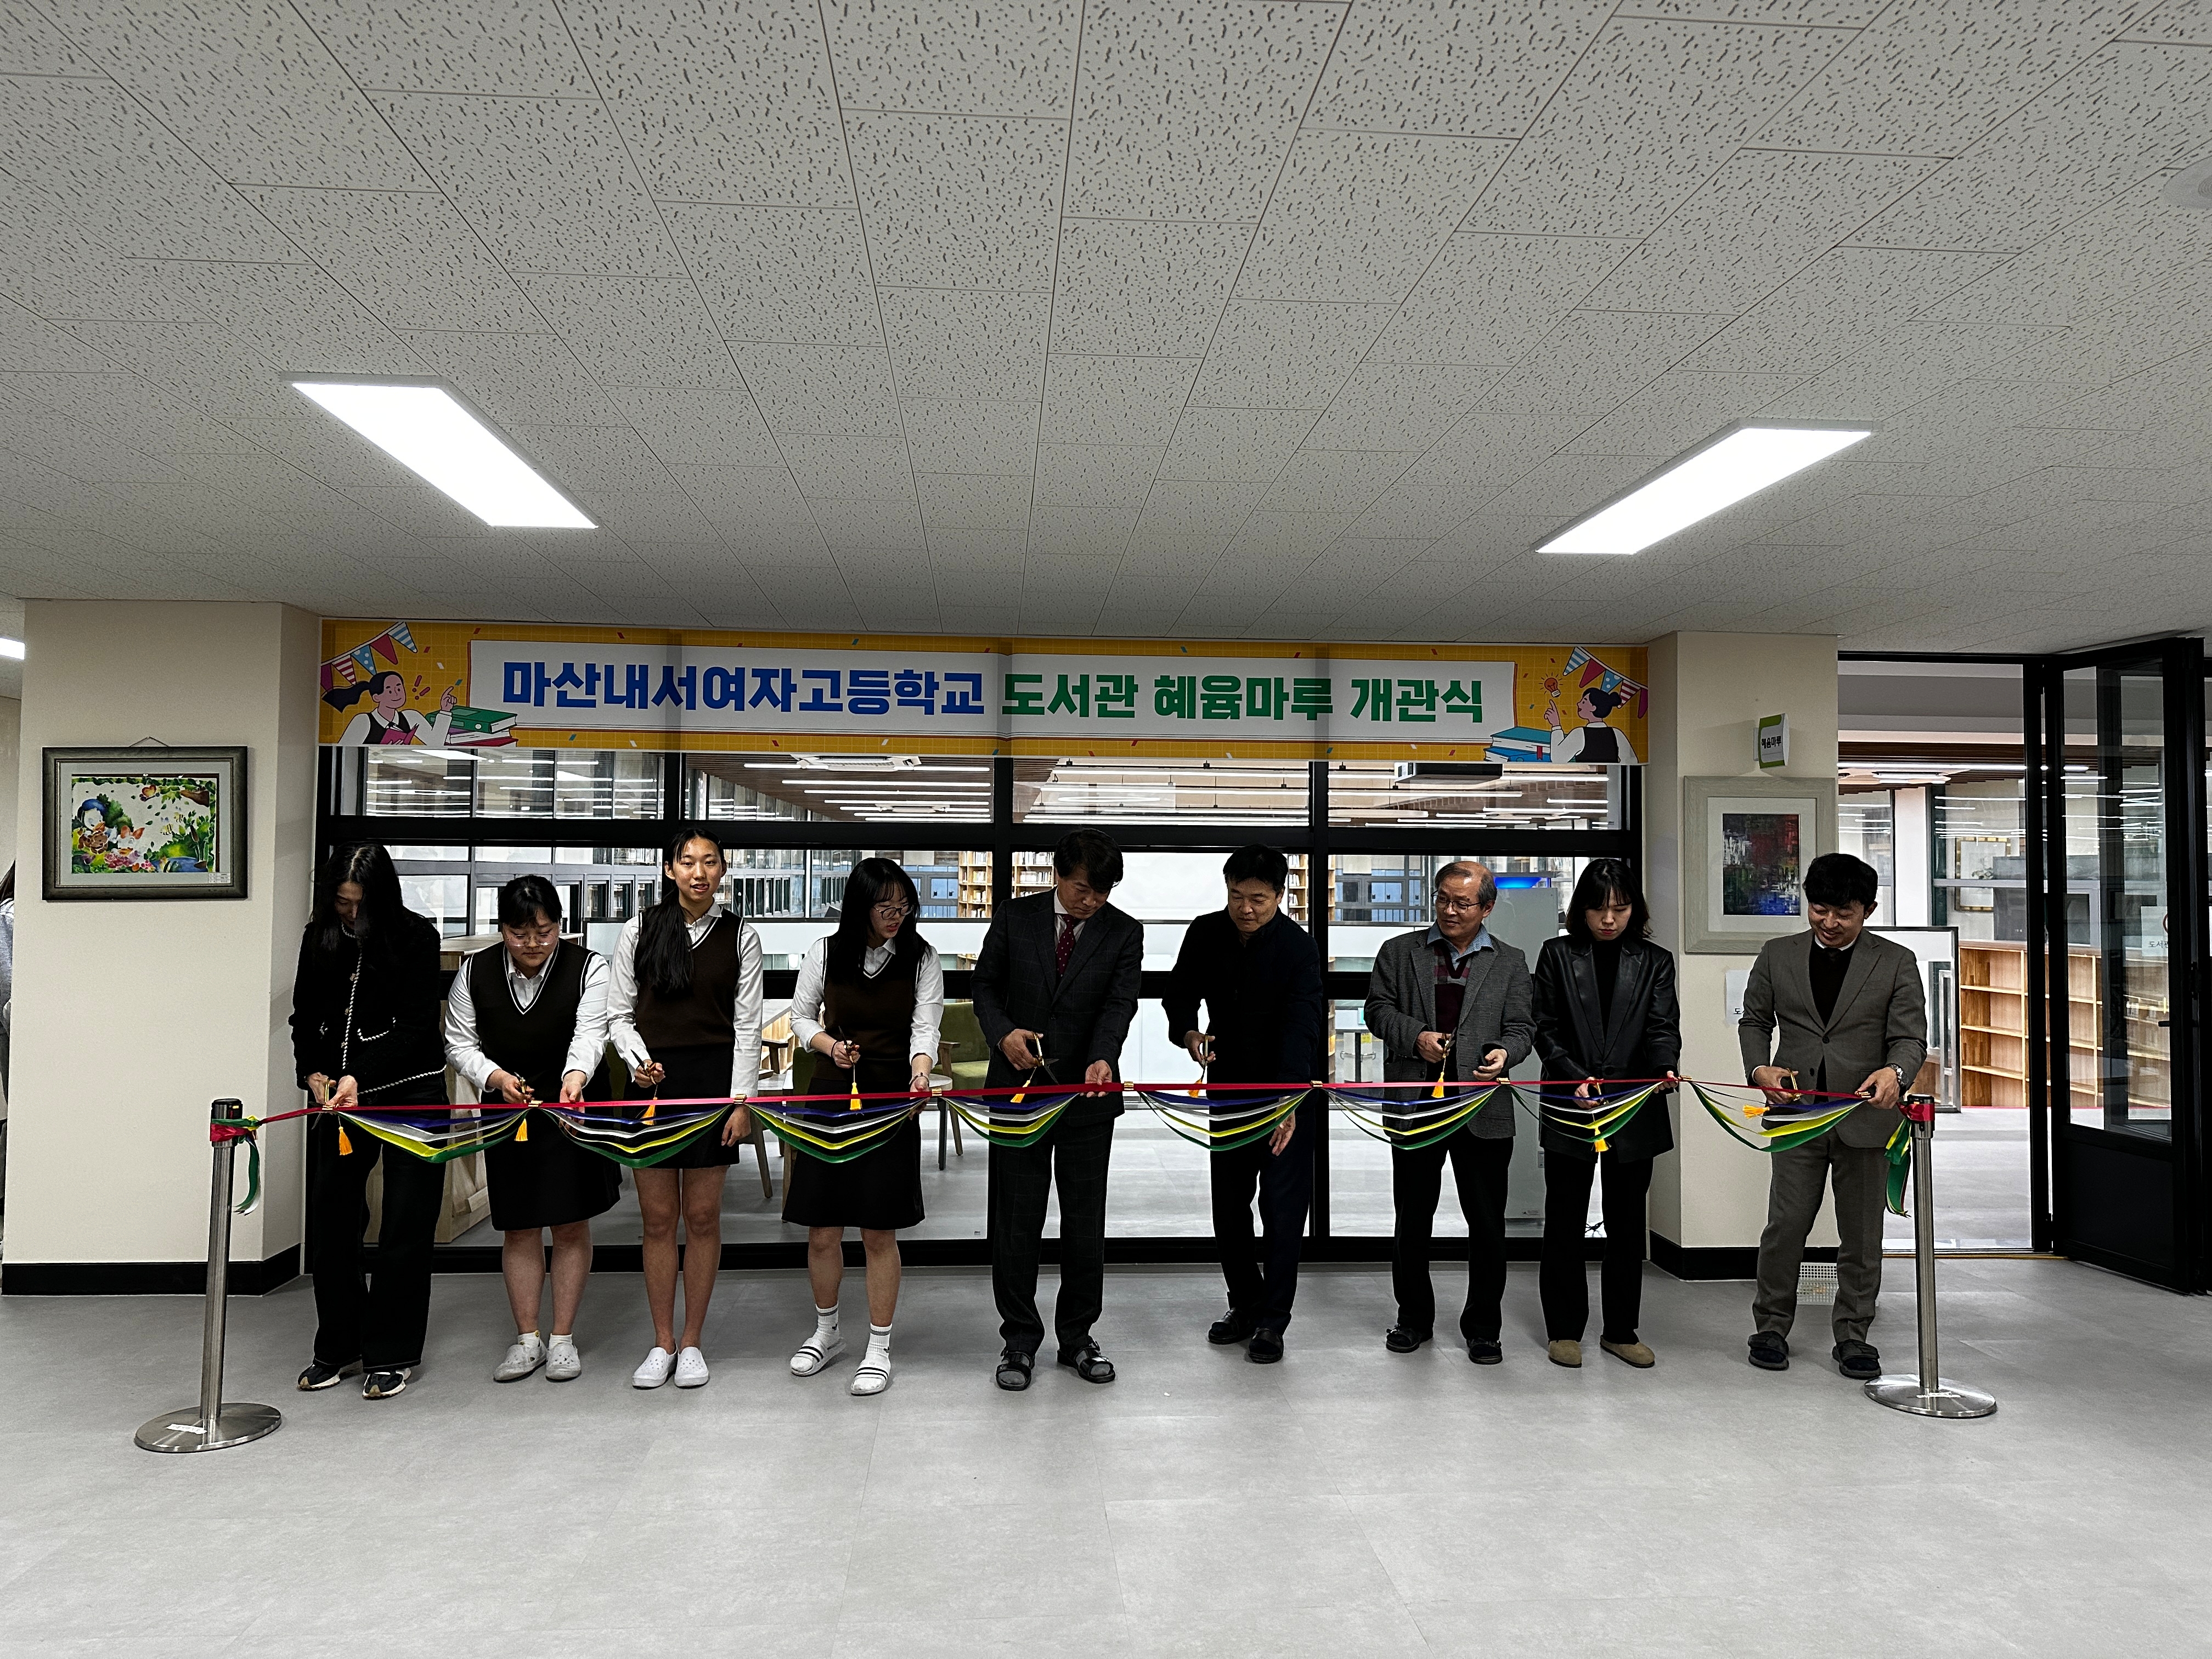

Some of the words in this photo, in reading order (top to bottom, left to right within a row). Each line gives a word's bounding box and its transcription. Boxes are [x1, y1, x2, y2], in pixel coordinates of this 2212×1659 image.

[503, 661, 985, 715] 마산내서여자고등학교
[1002, 673, 1138, 718] 도서관
[1154, 675, 1333, 721] 혜윰마루
[1350, 679, 1482, 723] 개관식
